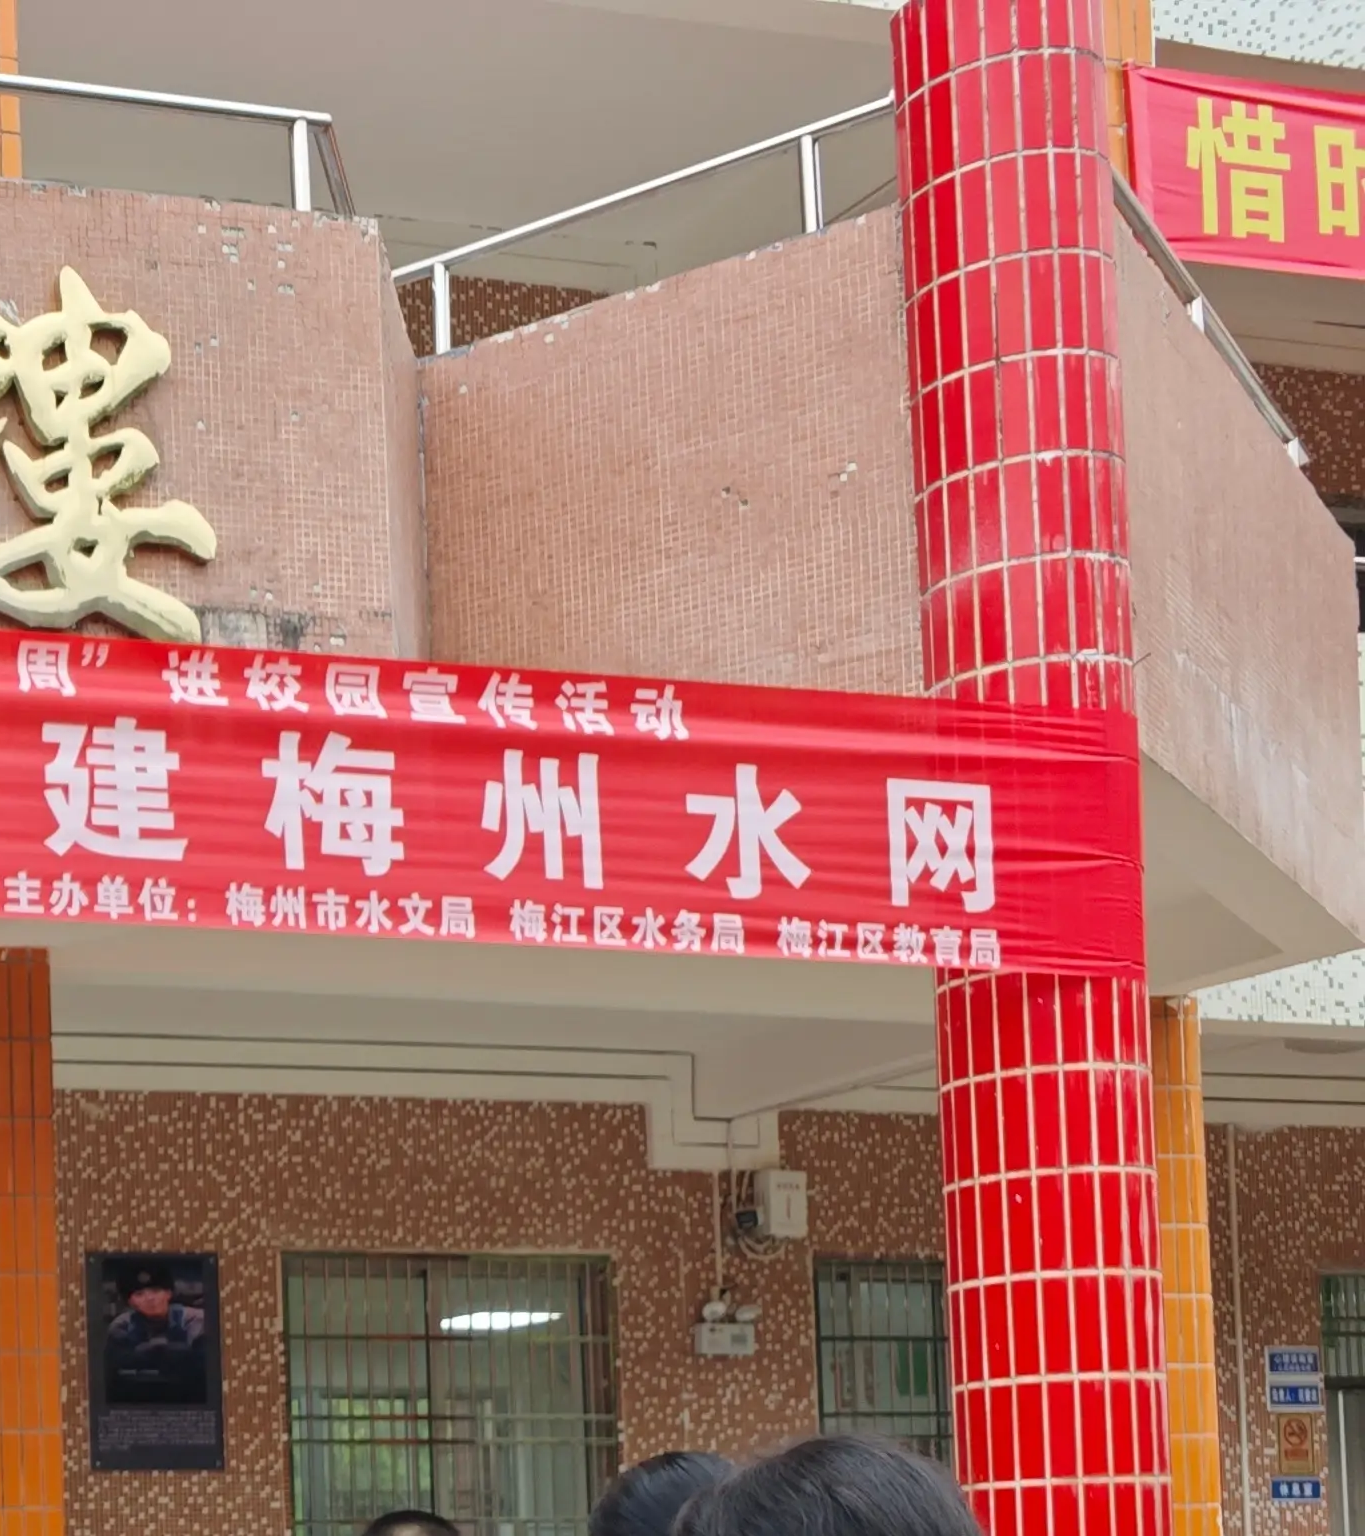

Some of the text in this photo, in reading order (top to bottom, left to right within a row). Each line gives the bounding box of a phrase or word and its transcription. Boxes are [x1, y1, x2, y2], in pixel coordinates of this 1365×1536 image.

[509, 899, 746, 955] 梅江区水务局
[776, 916, 1002, 967] 梅江区教育局
